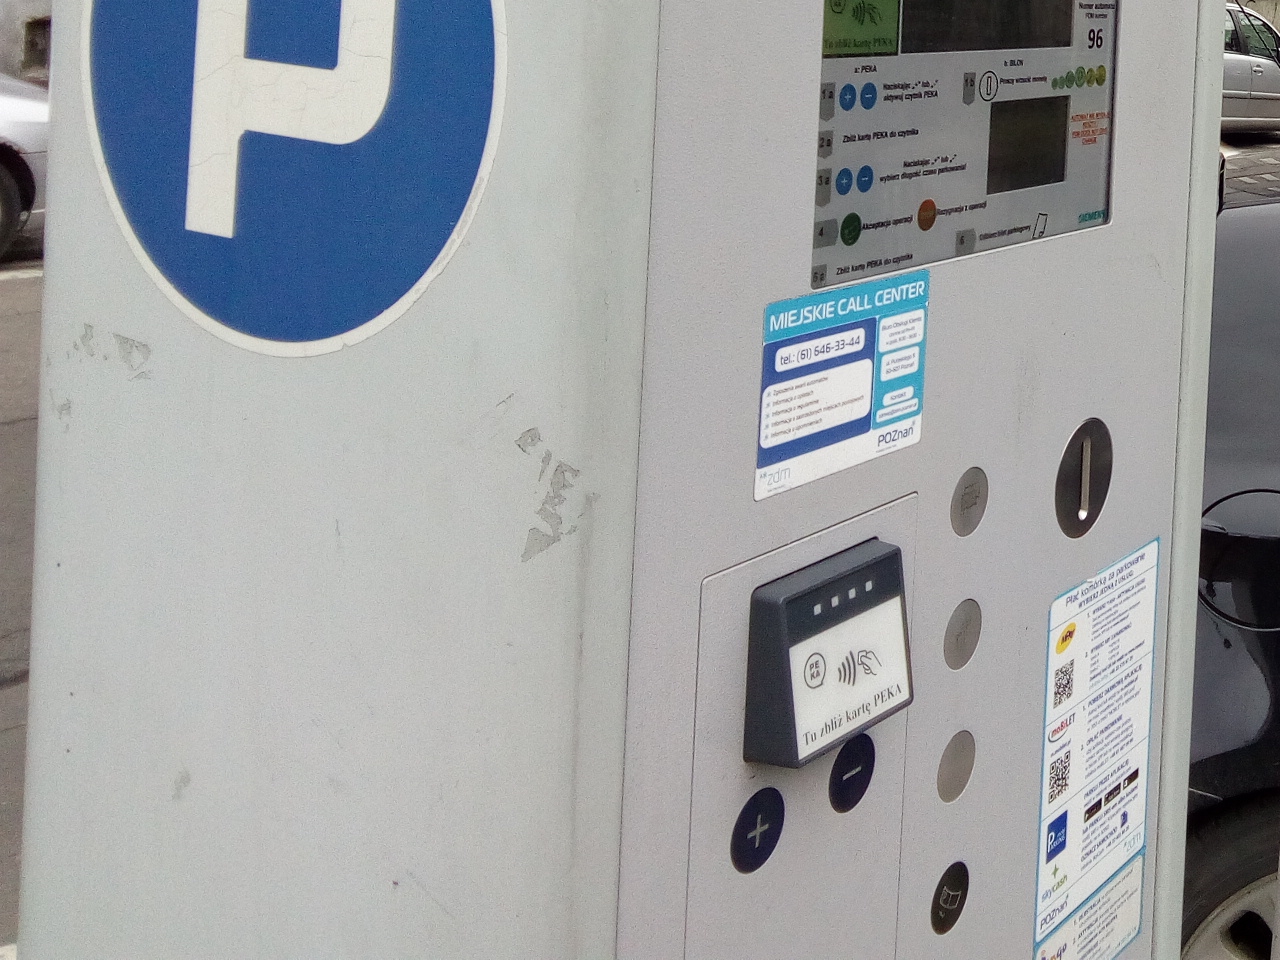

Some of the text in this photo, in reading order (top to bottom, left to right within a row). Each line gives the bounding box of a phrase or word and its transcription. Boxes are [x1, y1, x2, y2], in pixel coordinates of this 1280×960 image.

[1088, 28, 1103, 49] 96
[872, 131, 888, 141] PEKA
[889, 130, 897, 138] do
[818, 227, 824, 237] 4
[866, 258, 883, 269] PEKA
[769, 280, 926, 332] MIEJSKIE CALL CENTER
[779, 334, 861, 366] tel.: (61) 646-33-44
[766, 467, 792, 486] zdm
[1065, 591, 1079, 606] Płać
[1080, 574, 1106, 598] komórką
[1107, 571, 1114, 580] za
[1115, 551, 1145, 576] parkowanie
[802, 683, 903, 746] Tu zbliż kartę PEKA
